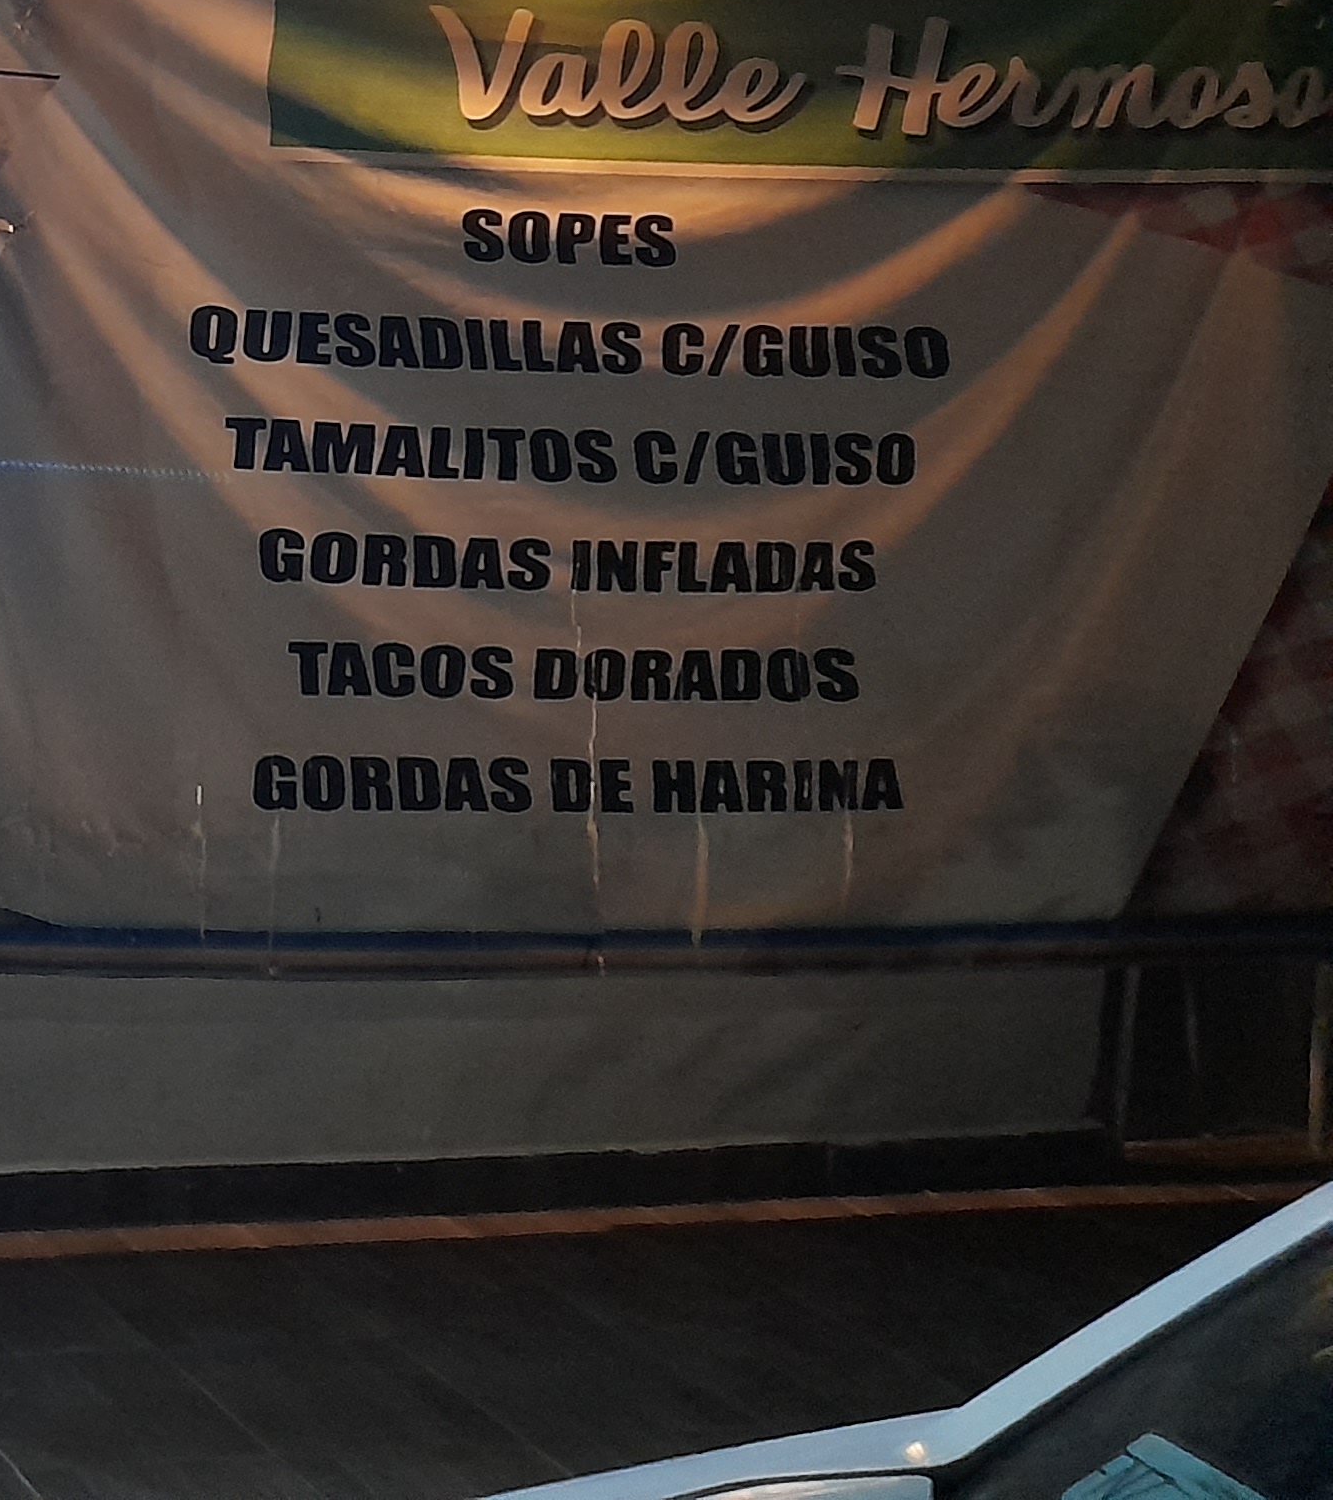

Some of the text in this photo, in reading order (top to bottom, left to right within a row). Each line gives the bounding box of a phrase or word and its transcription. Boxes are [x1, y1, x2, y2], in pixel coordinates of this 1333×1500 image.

[429, 4, 1333, 132] Valle Hermoso
[462, 208, 677, 267] SOPES
[189, 305, 950, 380] QUESADILLAS C/GUISO
[224, 416, 916, 487] TAMALITOS C/GUISO
[258, 527, 876, 593] GORDAS INFLADAS
[288, 641, 860, 702] TACOS DORADOS
[252, 753, 904, 814] GORDAS DE HARINA
